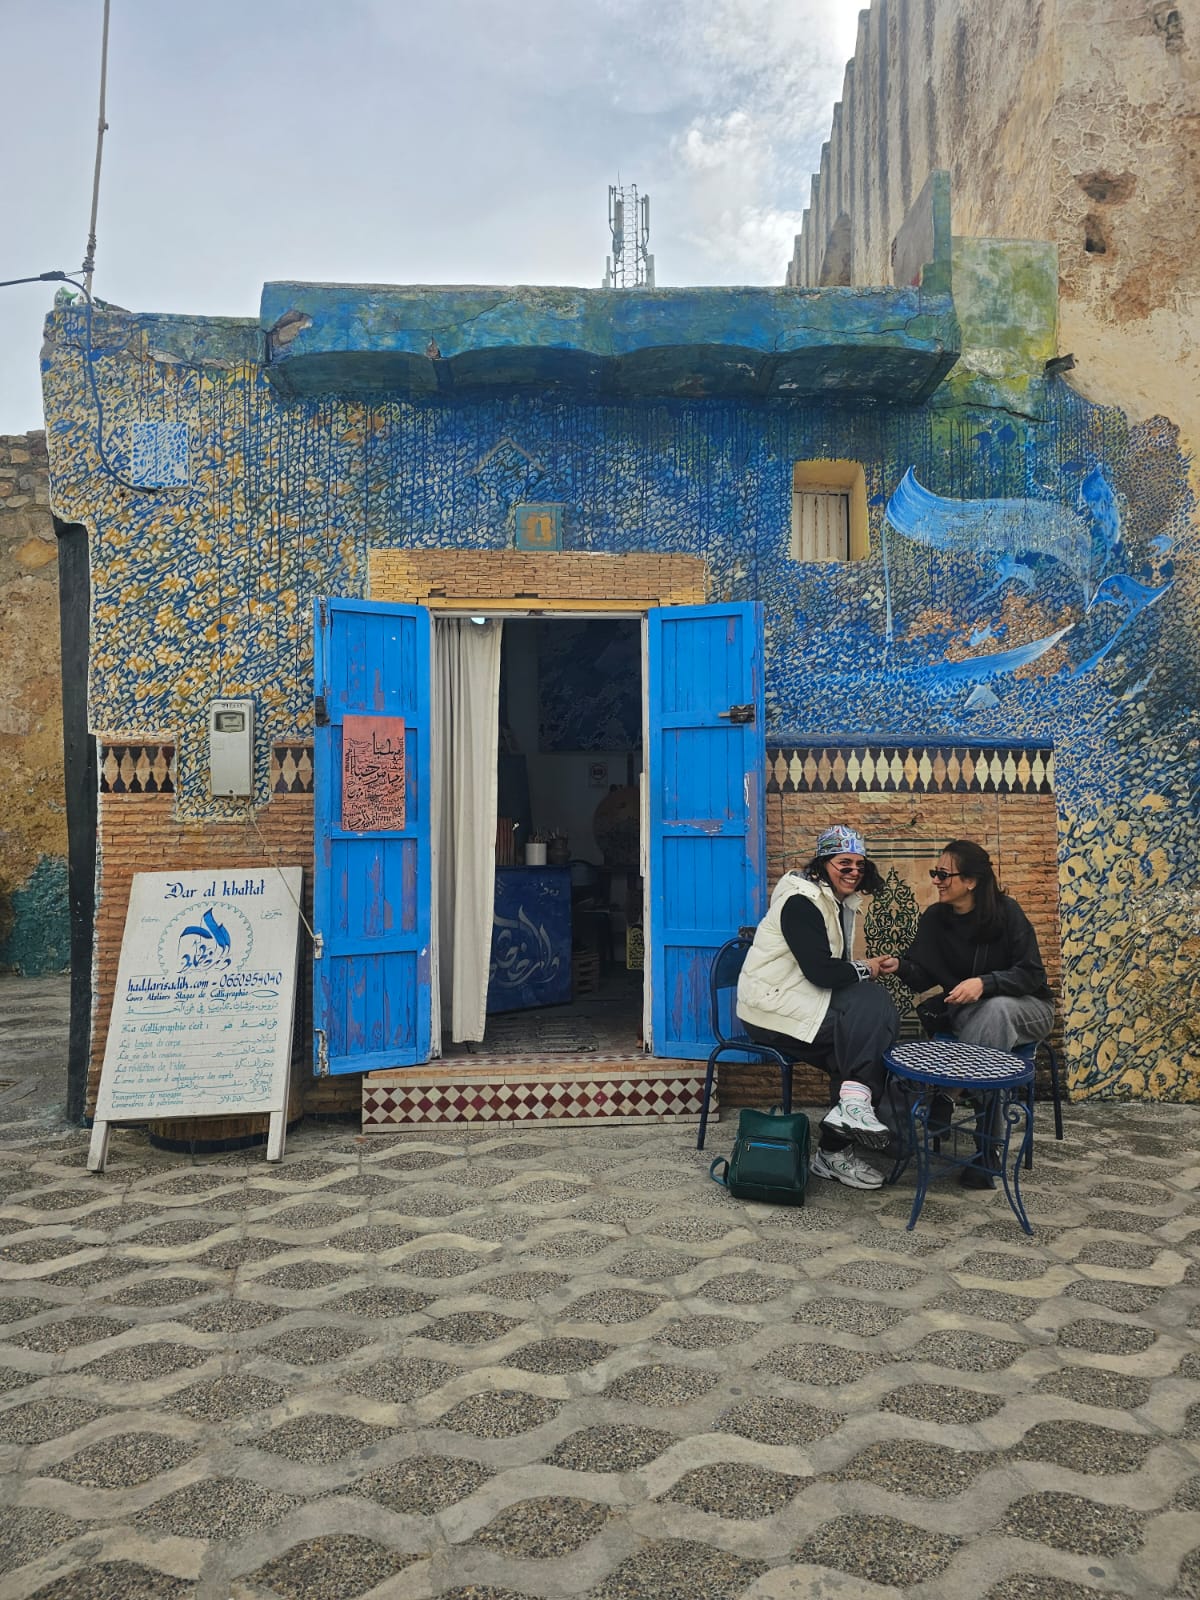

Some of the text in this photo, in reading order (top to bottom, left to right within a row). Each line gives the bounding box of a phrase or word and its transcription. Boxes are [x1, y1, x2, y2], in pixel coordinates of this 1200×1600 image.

[164, 879, 266, 899] Dar al khattat
[219, 972, 282, 988] 0660954040
[175, 987, 195, 1002] Stages
[210, 988, 249, 1003] Calligraphie
